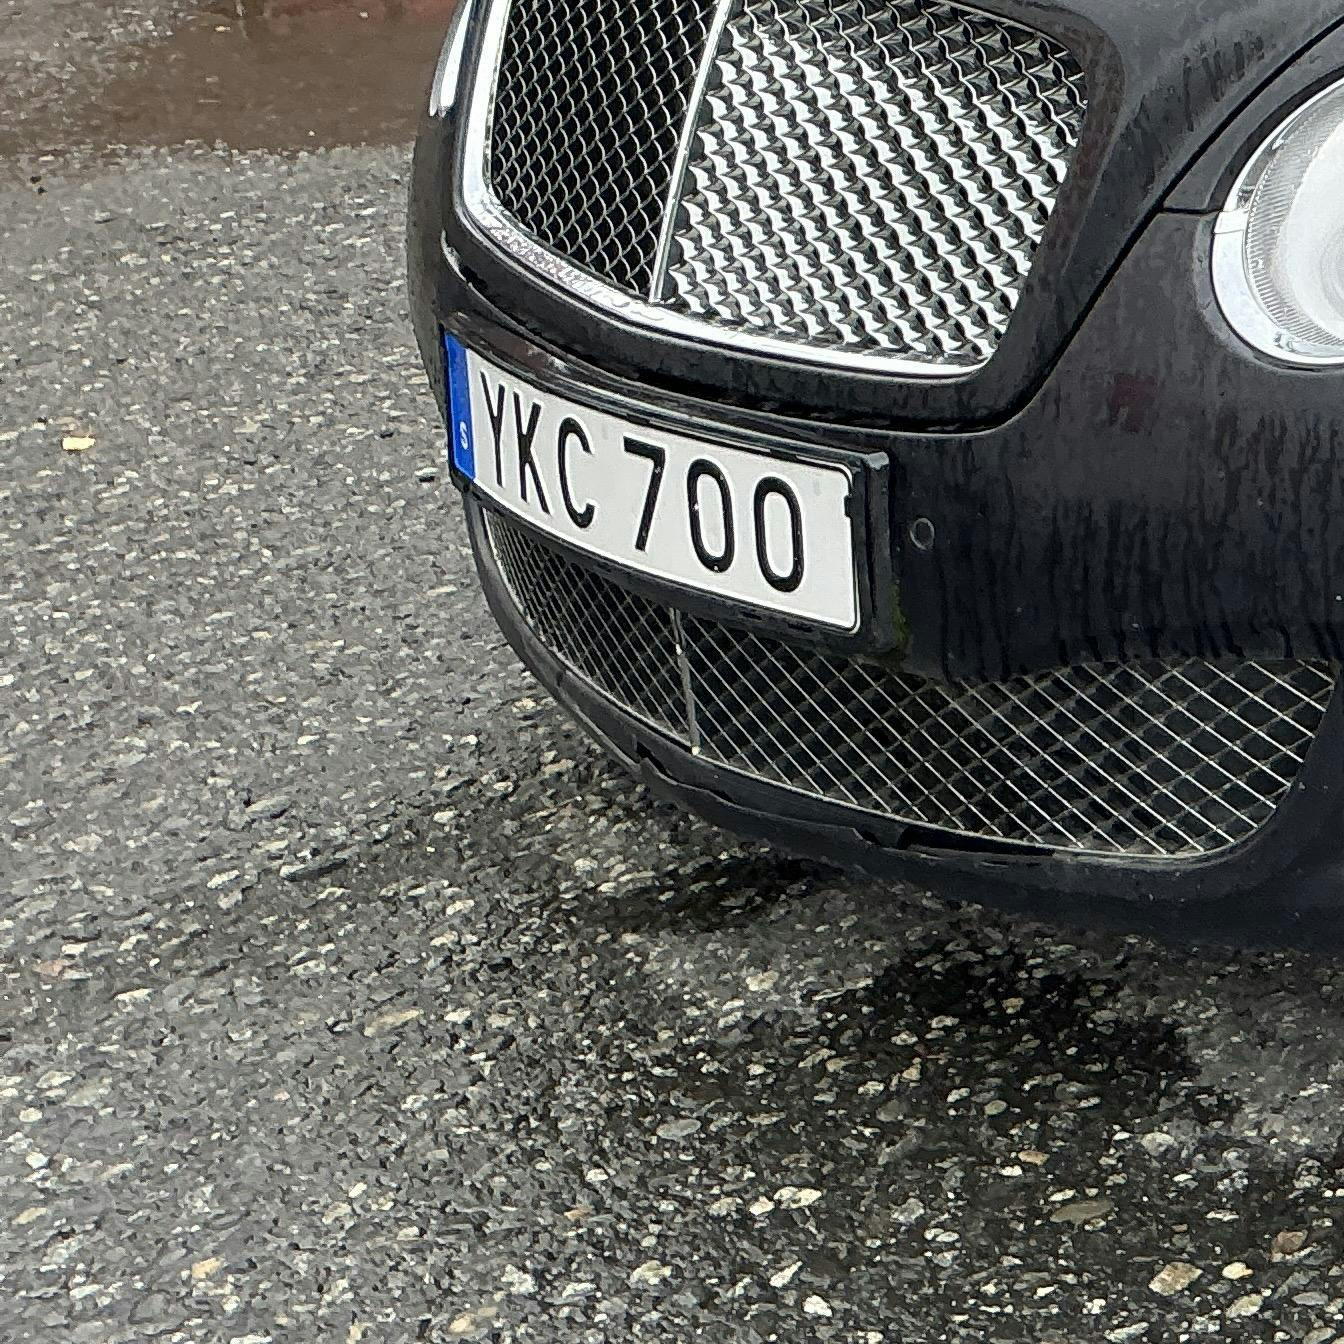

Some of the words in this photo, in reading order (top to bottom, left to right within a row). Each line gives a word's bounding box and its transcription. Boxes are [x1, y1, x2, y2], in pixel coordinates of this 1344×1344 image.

[459, 420, 469, 450] S
[480, 370, 595, 529] YKC
[623, 436, 804, 593] 700
